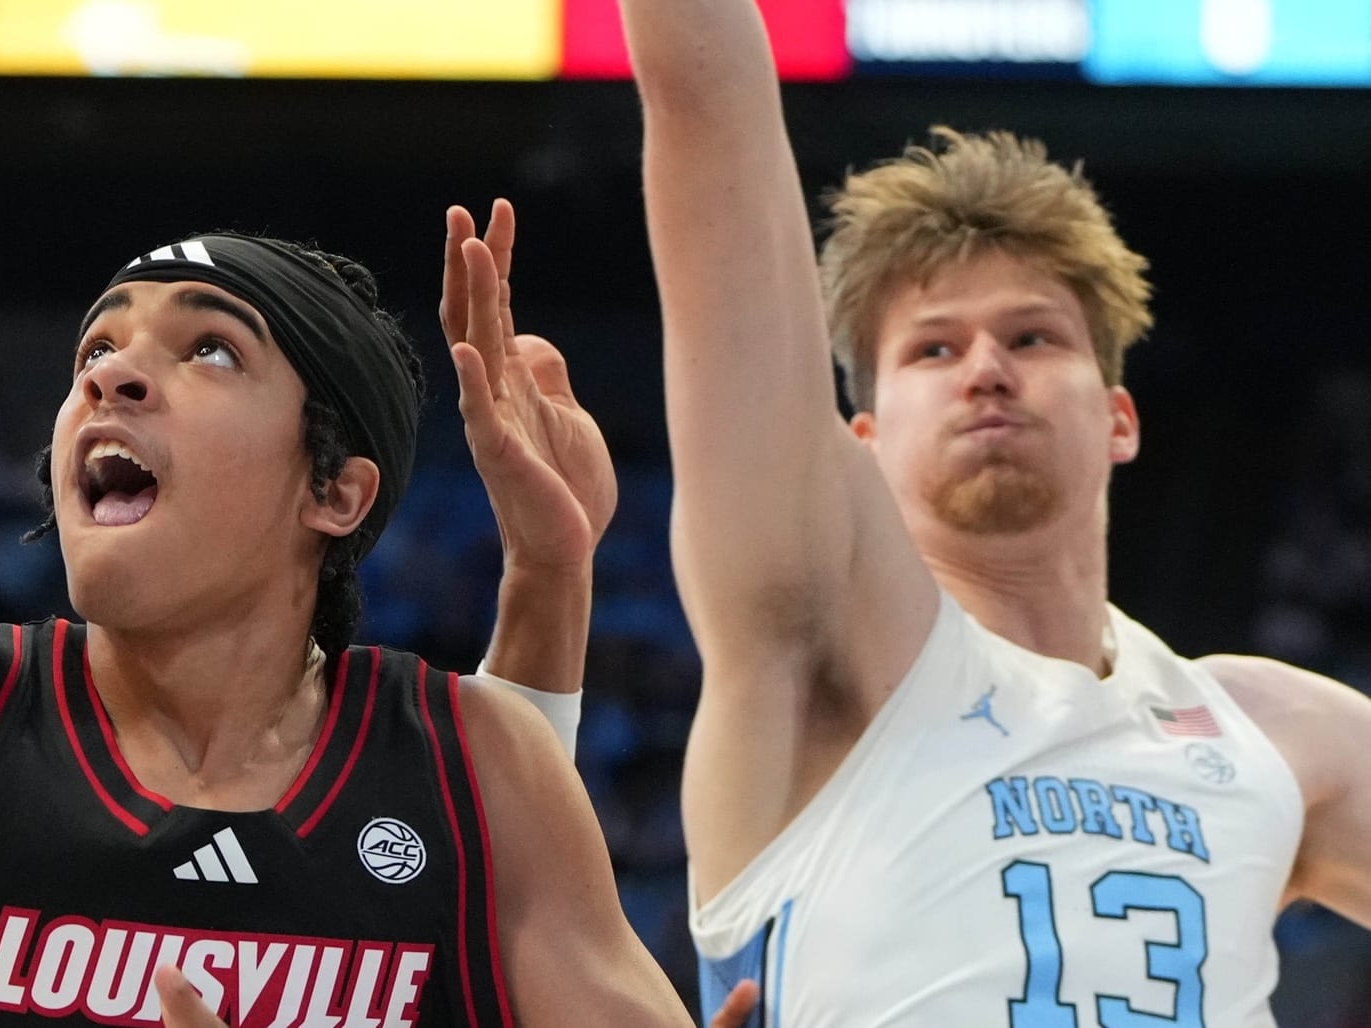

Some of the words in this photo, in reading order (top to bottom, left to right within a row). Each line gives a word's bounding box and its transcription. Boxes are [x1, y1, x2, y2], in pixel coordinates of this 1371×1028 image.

[367, 839, 421, 858] ACC
[985, 775, 1210, 863] NORTH
[1001, 859, 1208, 1028] 13
